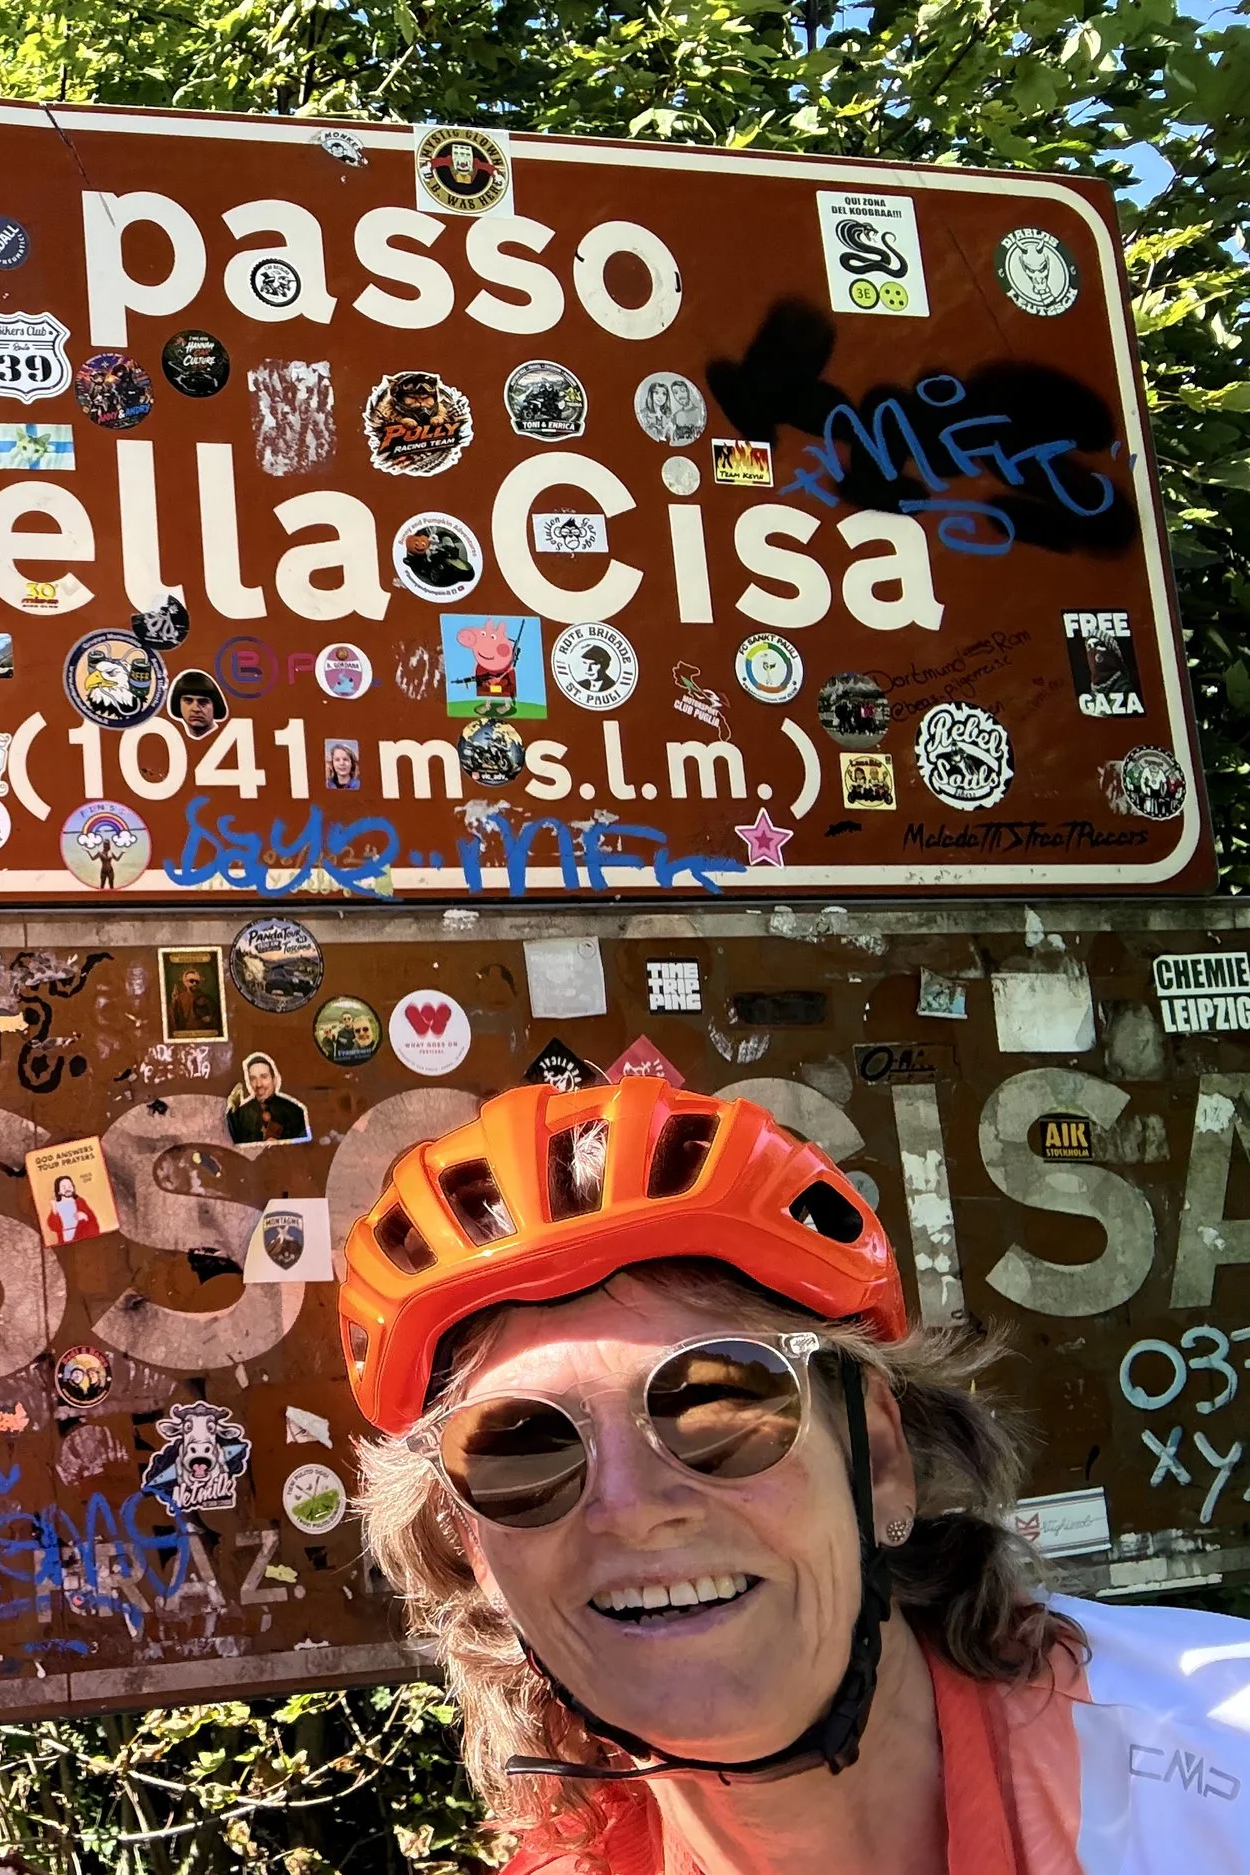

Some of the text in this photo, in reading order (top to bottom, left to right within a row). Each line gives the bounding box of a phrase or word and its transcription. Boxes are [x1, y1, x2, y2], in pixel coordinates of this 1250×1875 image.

[422, 128, 502, 167] MYSTIC CLOWN
[447, 194, 477, 210] WAS
[831, 205, 848, 215] DEL
[844, 196, 886, 208] QUI ZONA
[81, 190, 683, 348] passo
[856, 288, 871, 300] 3E
[26, 326, 47, 337] Club
[380, 420, 461, 450] POLLY
[522, 421, 539, 430] TONI
[548, 421, 576, 431] ENRICA
[393, 437, 455, 454] RACING TEAM
[719, 470, 740, 479] TEAM
[491, 450, 946, 633] Cisa
[1063, 612, 1131, 638] FREE
[558, 626, 632, 665] ROTE BRIGADE
[738, 634, 799, 660] FC SANKT PAULI
[862, 654, 964, 694] Dortmund
[586, 687, 622, 705] PAULI
[1078, 692, 1145, 716] GAZA
[673, 699, 693, 716] CLUB
[930, 711, 1002, 758] Rebel
[933, 758, 1000, 788] Souls
[646, 962, 700, 978] TIME
[1156, 956, 1248, 990] CHEMIE
[648, 978, 700, 994] TRIP
[1160, 998, 1250, 1033] LEIPZIG
[405, 1041, 424, 1049] WHAT
[1045, 1122, 1088, 1148] AIK
[35, 1145, 94, 1165] GOD ANSWERS
[61, 1153, 95, 1166] PRAYERS
[1045, 1147, 1090, 1158] STOCKHOLM
[173, 1473, 235, 1507] Netmilk
[1128, 1743, 1242, 1802] CMP
